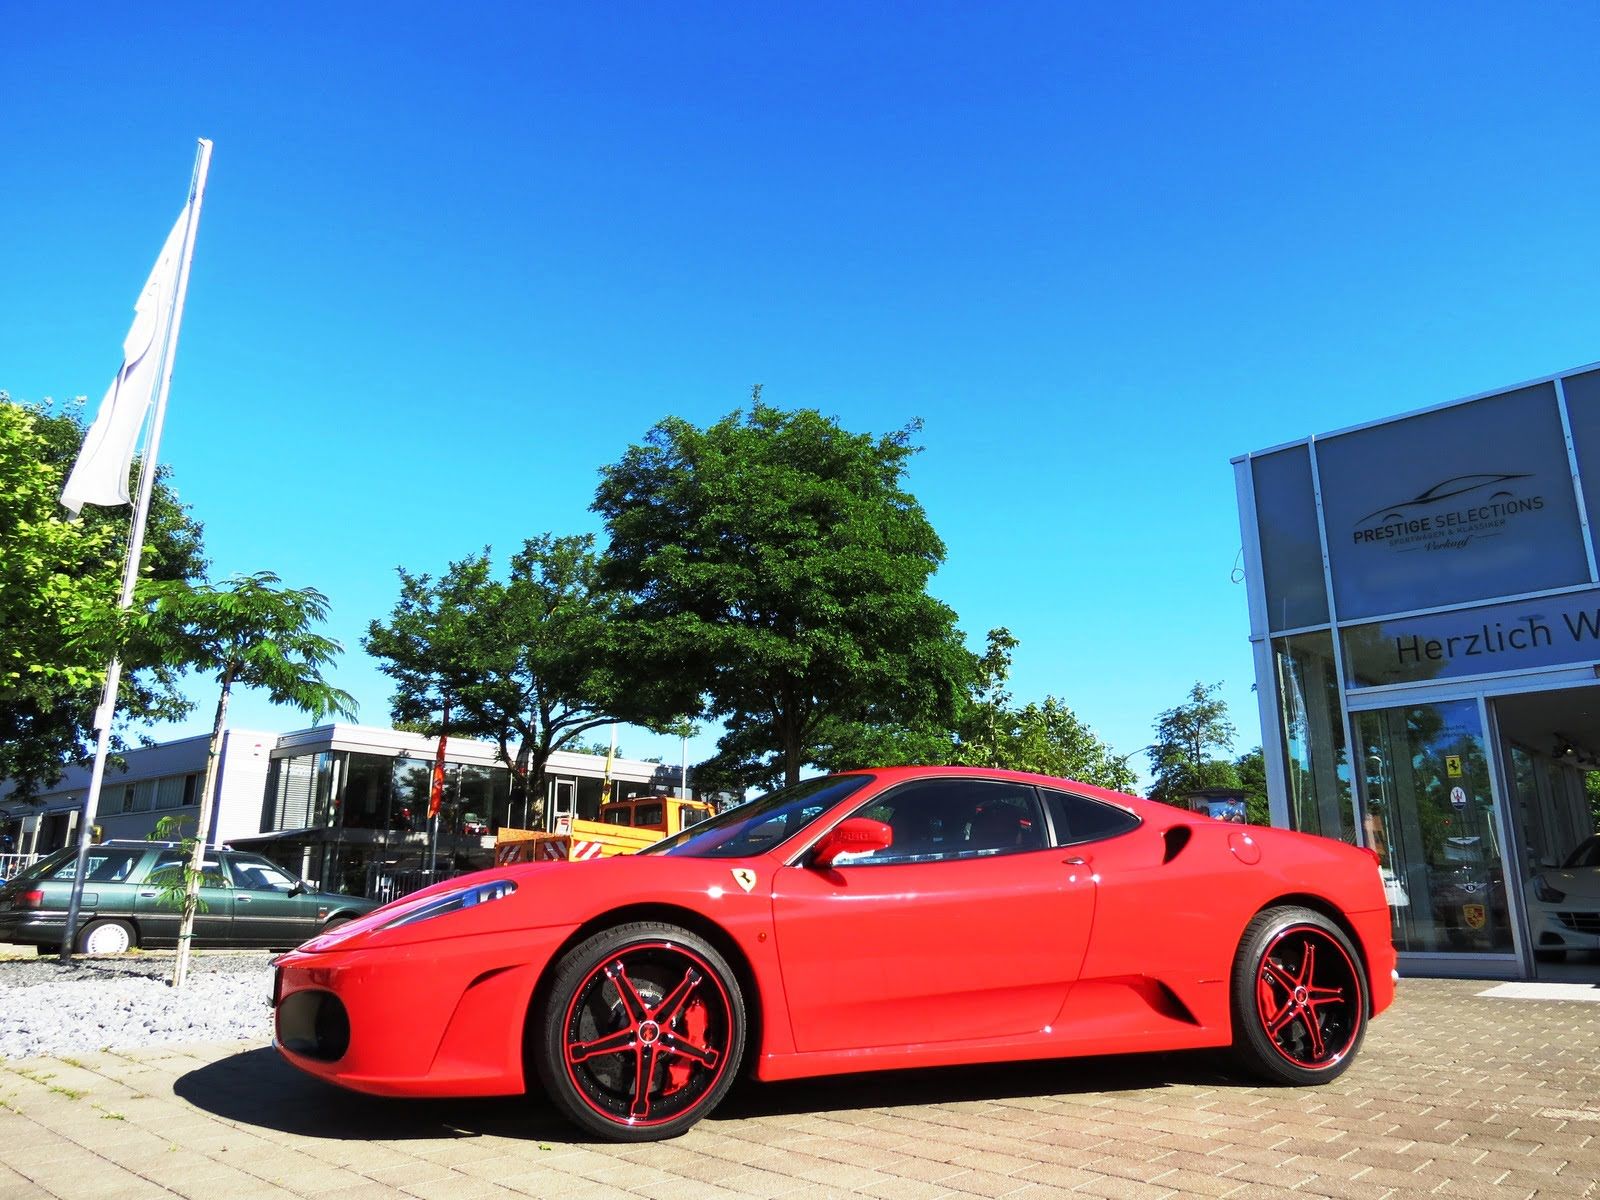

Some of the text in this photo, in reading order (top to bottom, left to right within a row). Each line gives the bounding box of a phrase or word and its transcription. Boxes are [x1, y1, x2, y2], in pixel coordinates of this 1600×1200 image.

[1353, 496, 1545, 545] PRESTIGE SELECTIONS
[1424, 534, 1474, 552] Verkauf
[1396, 617, 1552, 664] Herzlich
